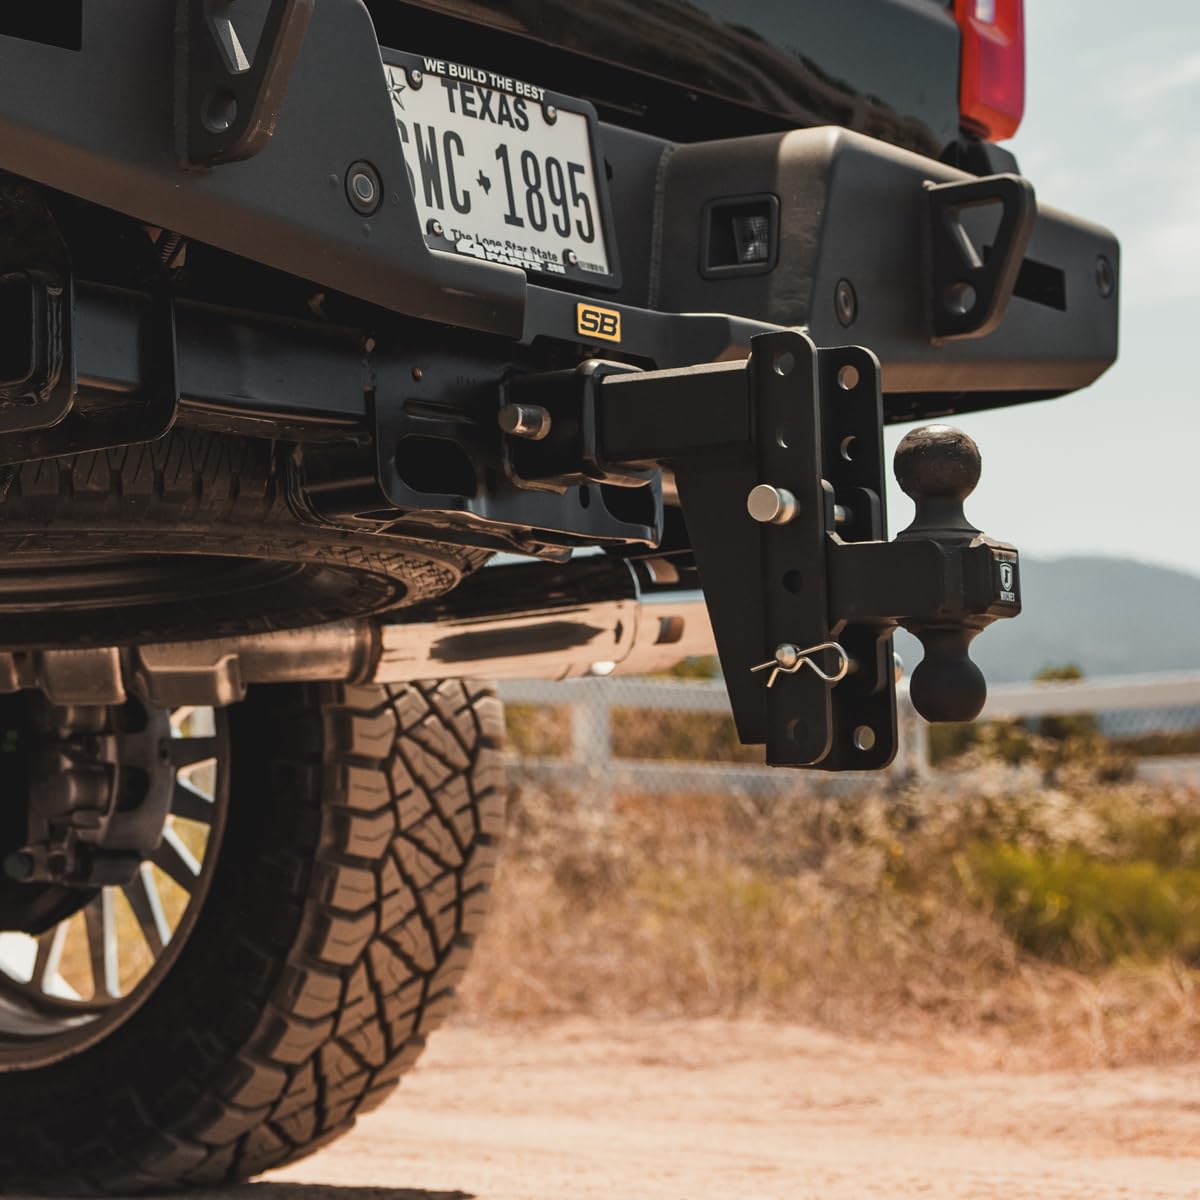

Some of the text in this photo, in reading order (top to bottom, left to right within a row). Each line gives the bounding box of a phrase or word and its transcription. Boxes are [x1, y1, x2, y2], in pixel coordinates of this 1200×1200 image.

[424, 58, 545, 101] WE BUILD THE BEST
[440, 79, 529, 132] TEXAS
[495, 143, 595, 245] 1895
[580, 309, 618, 337] SB
